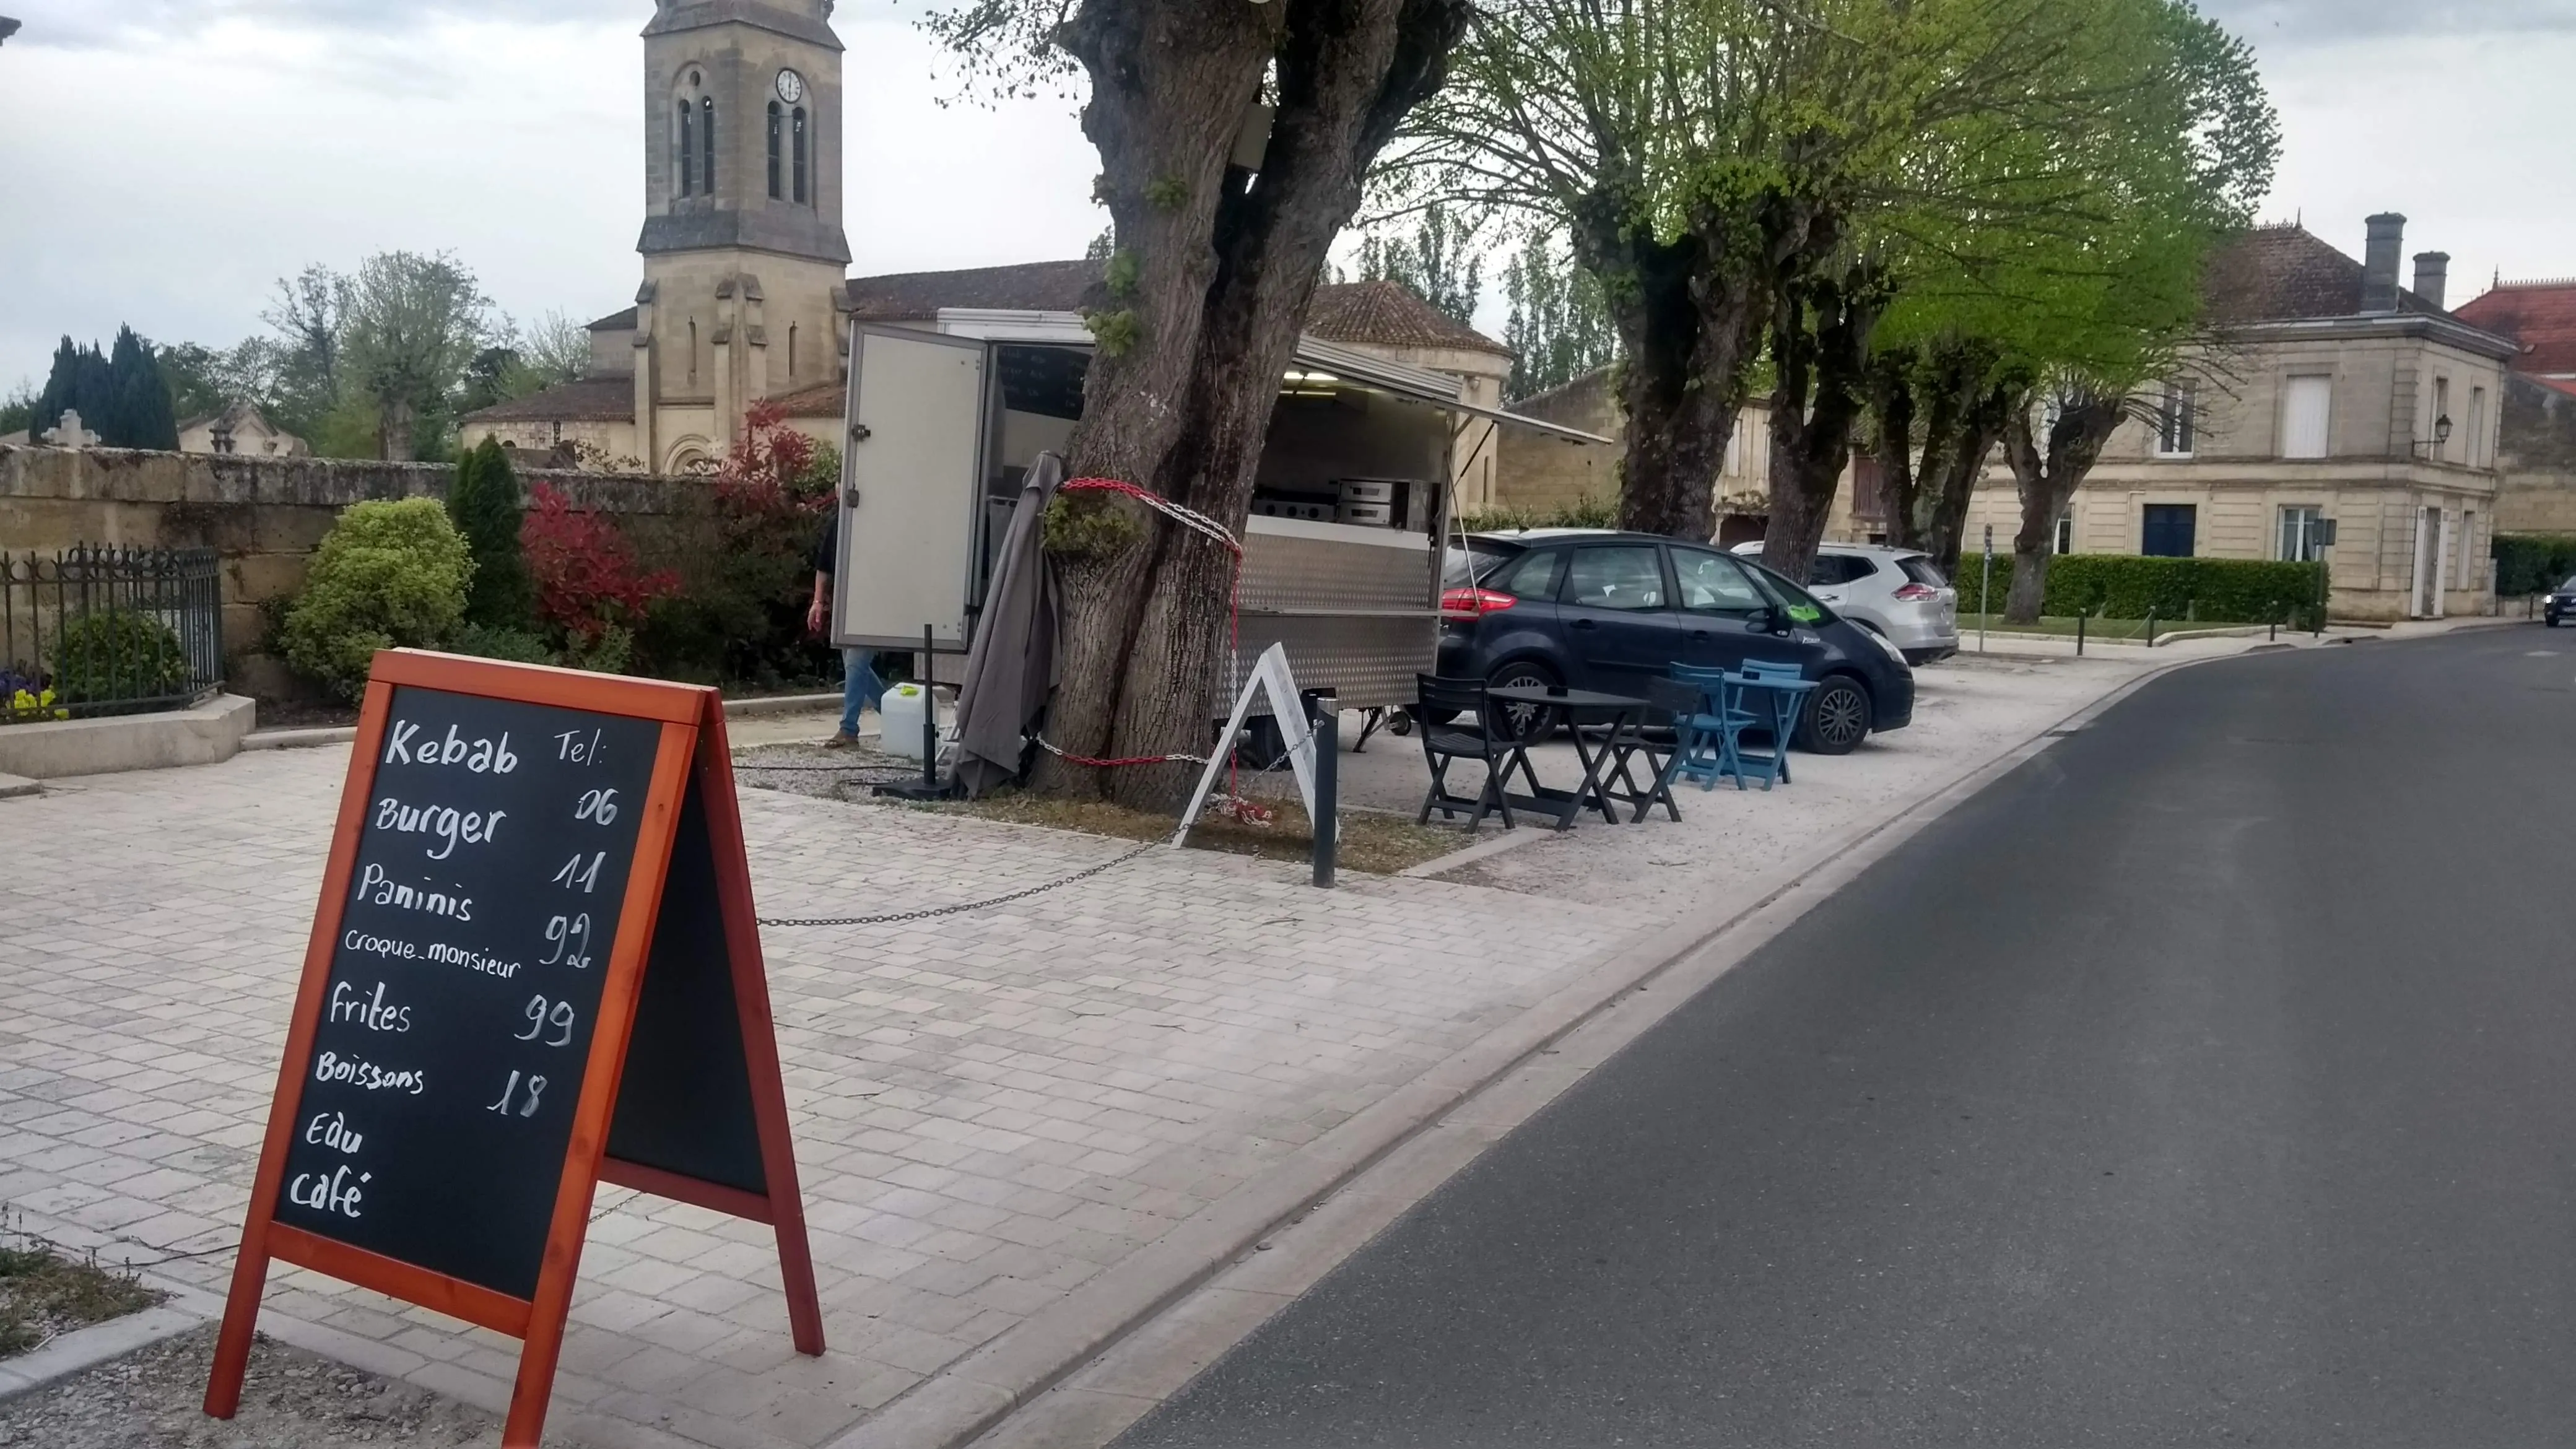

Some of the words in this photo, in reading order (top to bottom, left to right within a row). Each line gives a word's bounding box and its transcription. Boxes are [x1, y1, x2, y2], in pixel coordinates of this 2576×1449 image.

[385, 719, 518, 775] Kebab
[375, 798, 507, 859] Burger
[575, 788, 619, 825] 06
[357, 863, 472, 921] Paninis
[551, 851, 606, 893] 11
[539, 913, 591, 968] 92
[514, 994, 575, 1046] 99
[315, 1051, 424, 1094] Boissons
[486, 1069, 547, 1117] 18
[306, 1111, 363, 1154] Eau
